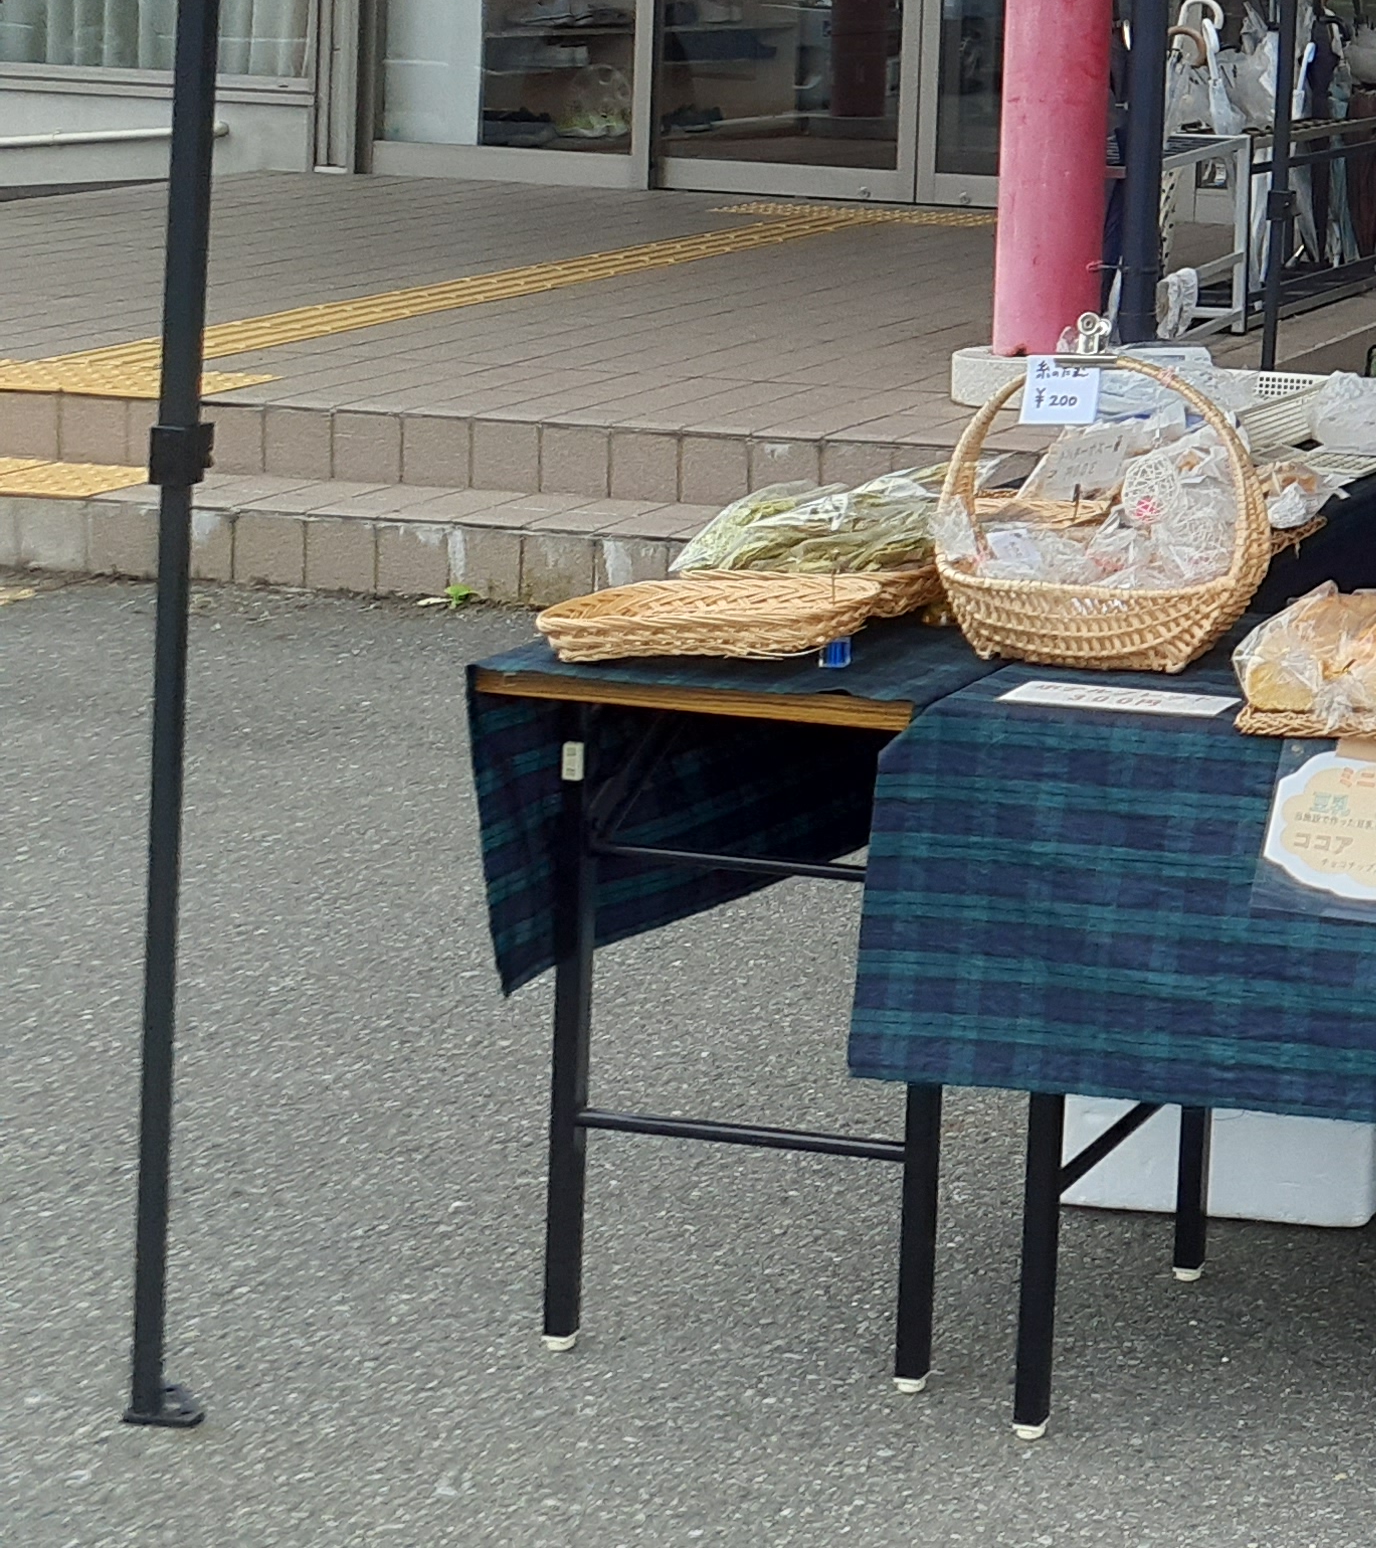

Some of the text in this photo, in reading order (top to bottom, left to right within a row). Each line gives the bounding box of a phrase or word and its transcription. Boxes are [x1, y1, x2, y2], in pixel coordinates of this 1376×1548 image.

[1035, 388, 1077, 408] ¥200
[1309, 792, 1350, 816] 豆乳
[1293, 832, 1354, 855] ココア
